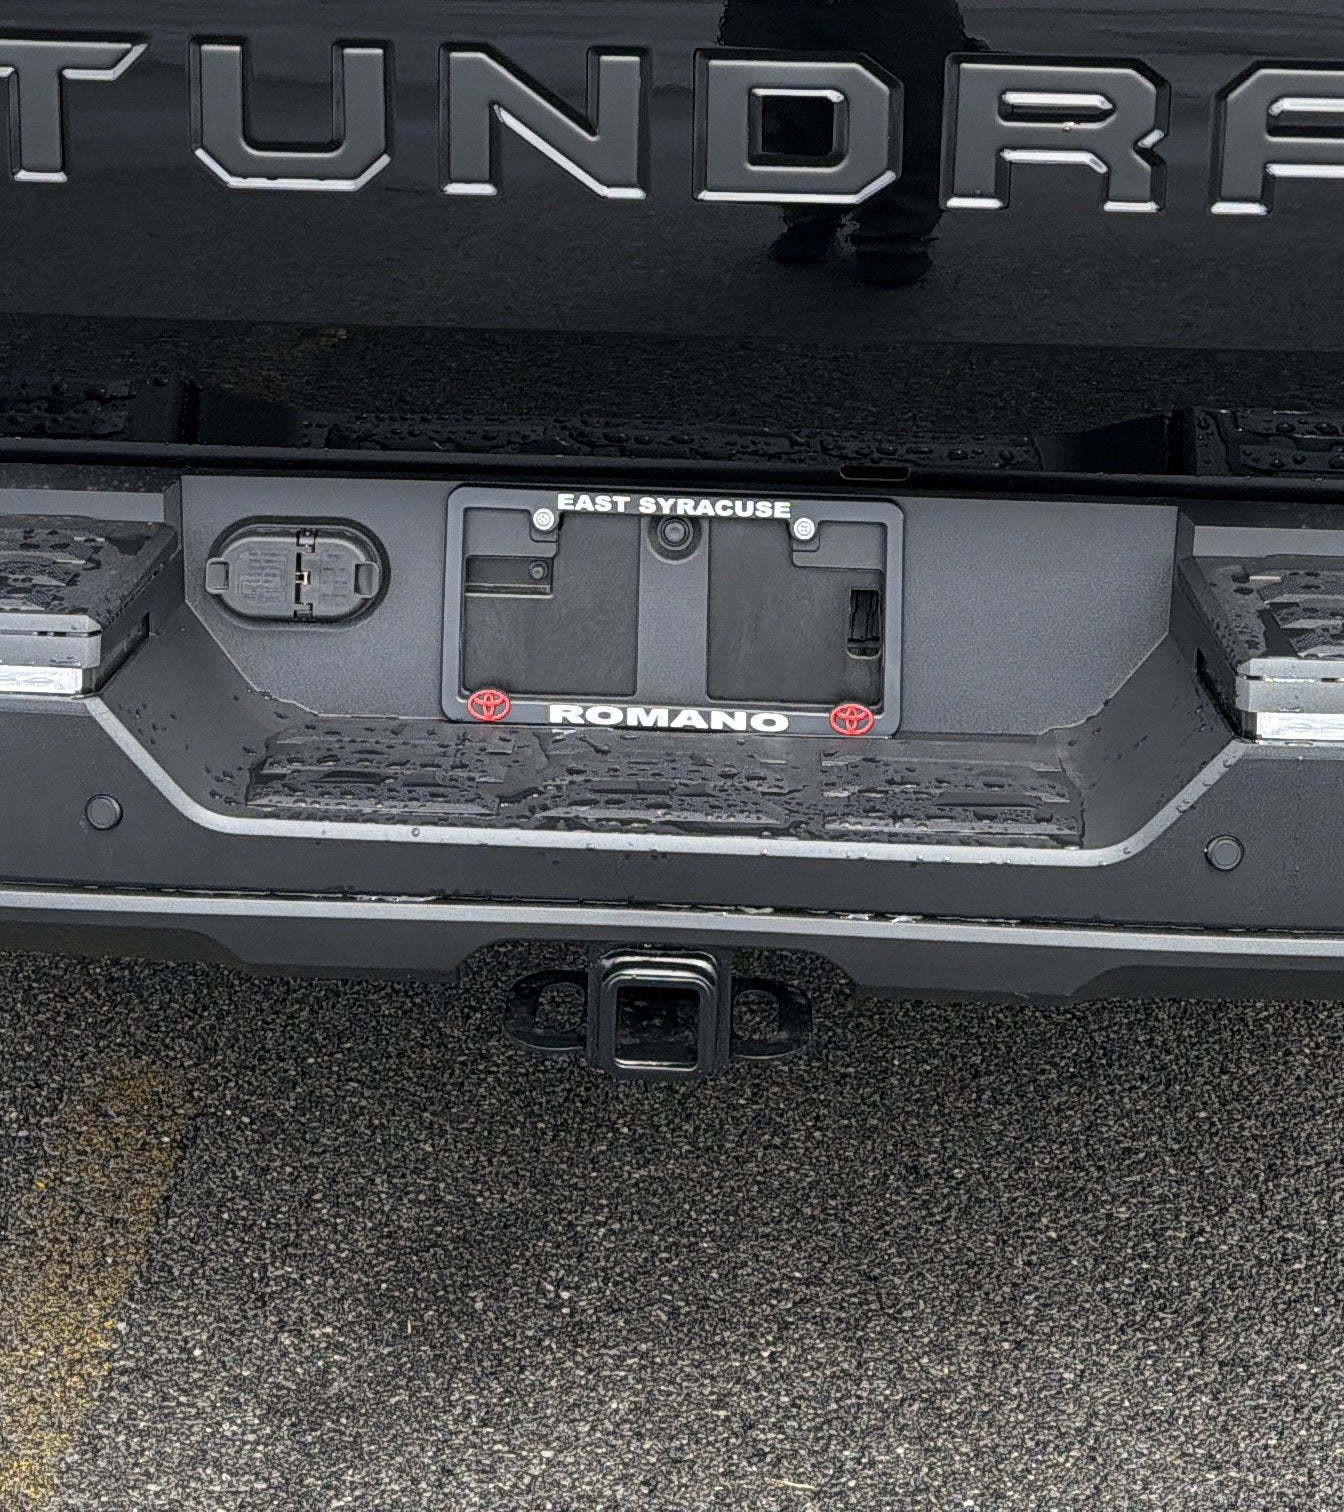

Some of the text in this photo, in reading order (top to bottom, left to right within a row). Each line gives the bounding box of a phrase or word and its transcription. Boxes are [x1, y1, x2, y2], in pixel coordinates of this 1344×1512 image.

[557, 493, 792, 519] EAST SYRACUSE
[548, 703, 790, 734] ROMANO
